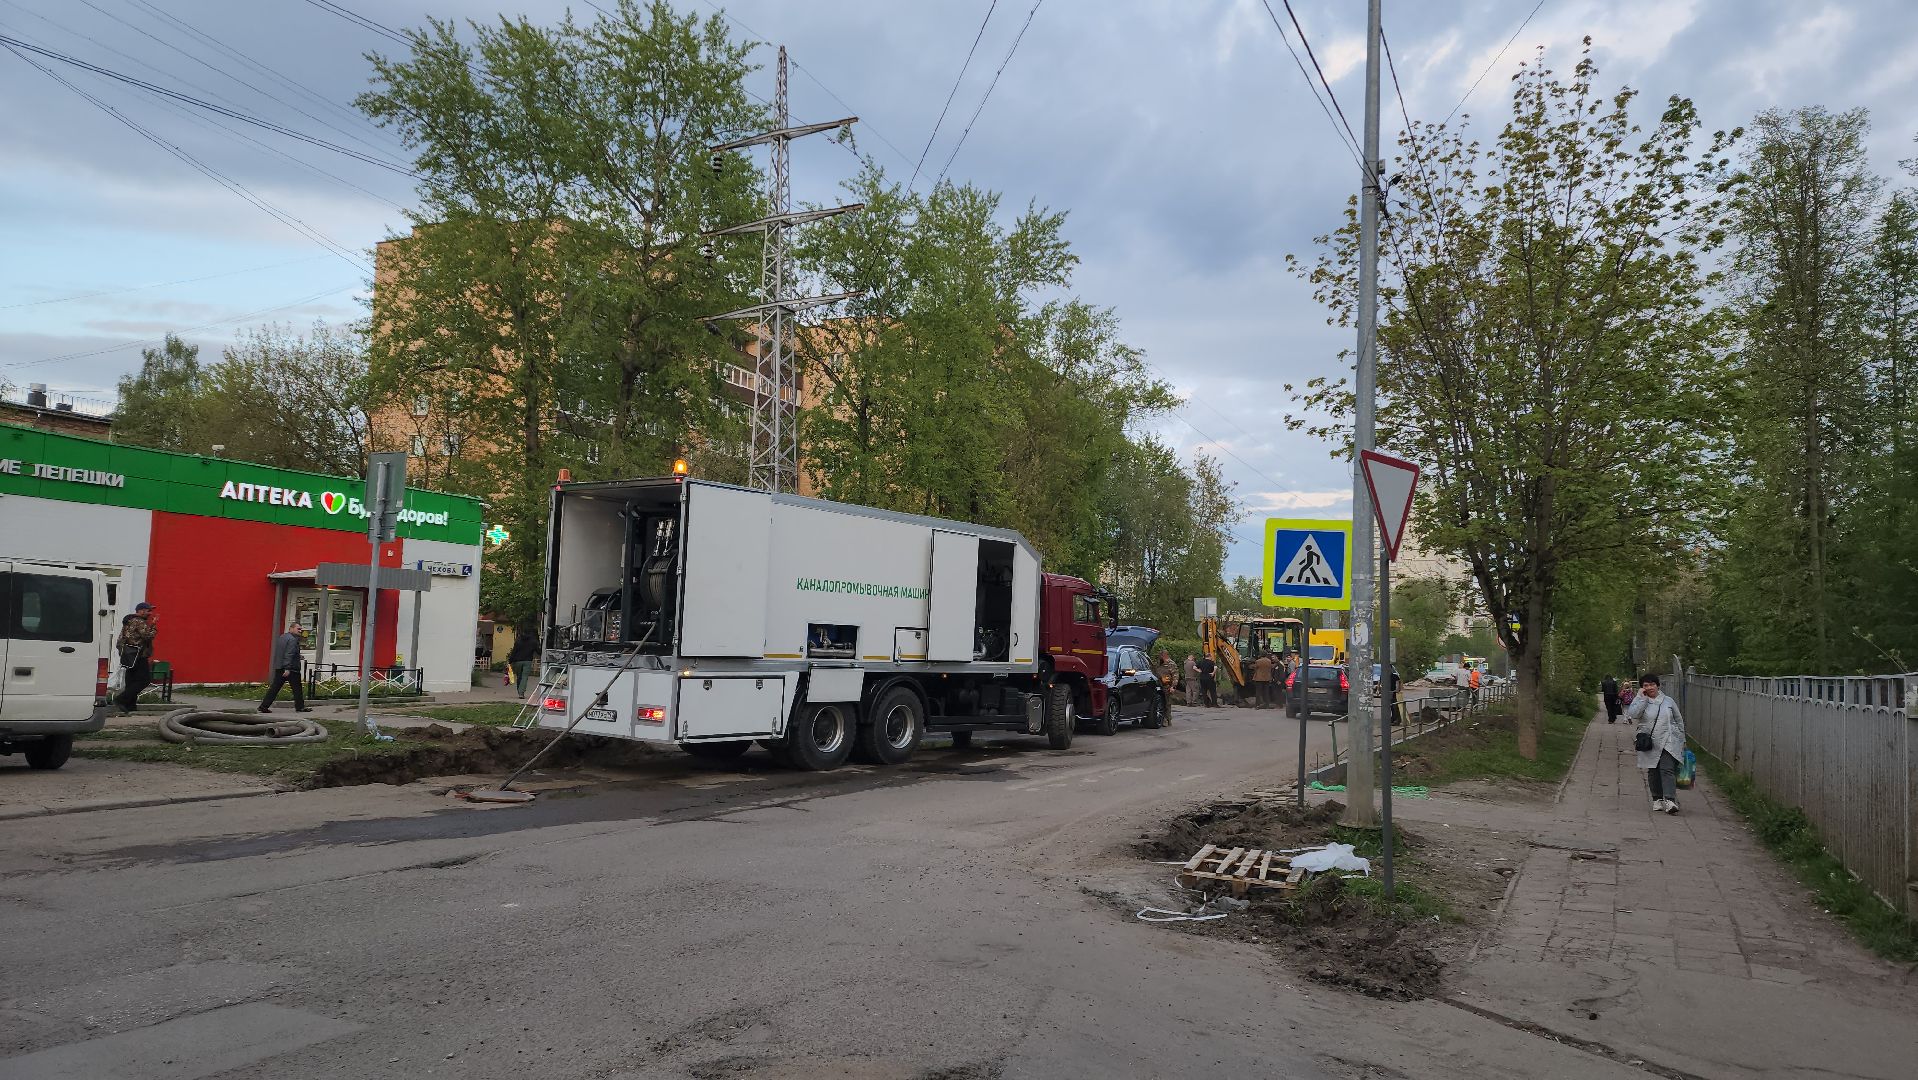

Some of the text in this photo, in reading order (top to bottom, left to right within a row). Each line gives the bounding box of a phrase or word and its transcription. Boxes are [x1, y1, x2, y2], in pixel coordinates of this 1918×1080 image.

[32, 463, 125, 488] ЛЕПЕШКИ
[220, 480, 449, 527] АПТЕКА Бу доров!
[796, 577, 899, 598] КАНАЛОПРОМЫВОЧНАЯ
